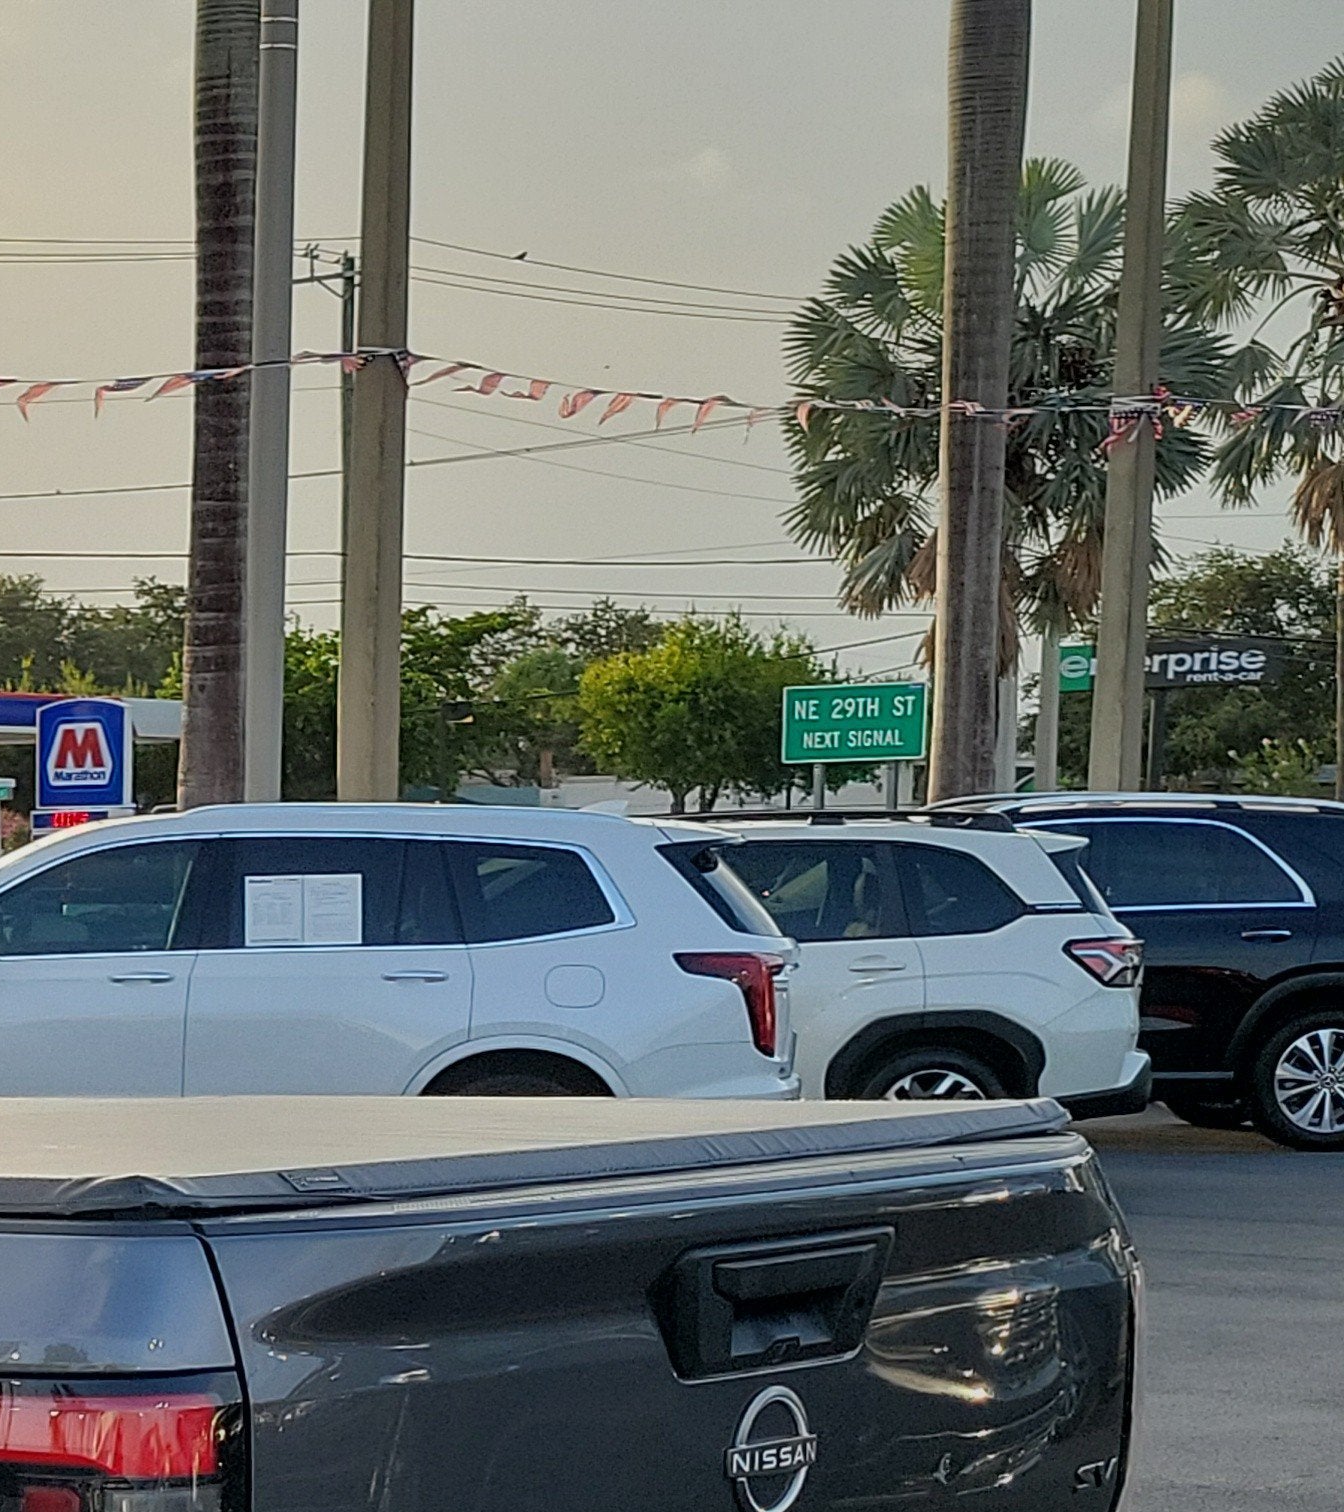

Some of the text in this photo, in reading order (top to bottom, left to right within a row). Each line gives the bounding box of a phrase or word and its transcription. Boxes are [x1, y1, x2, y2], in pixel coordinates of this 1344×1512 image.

[1186, 671, 1265, 682] rent-a-car
[794, 695, 916, 720] NE 29TH ST
[54, 727, 106, 769] M
[803, 729, 905, 749] NEXT SIGNAL
[53, 770, 107, 781] Marathon
[730, 1439, 818, 1475] NISSAN
